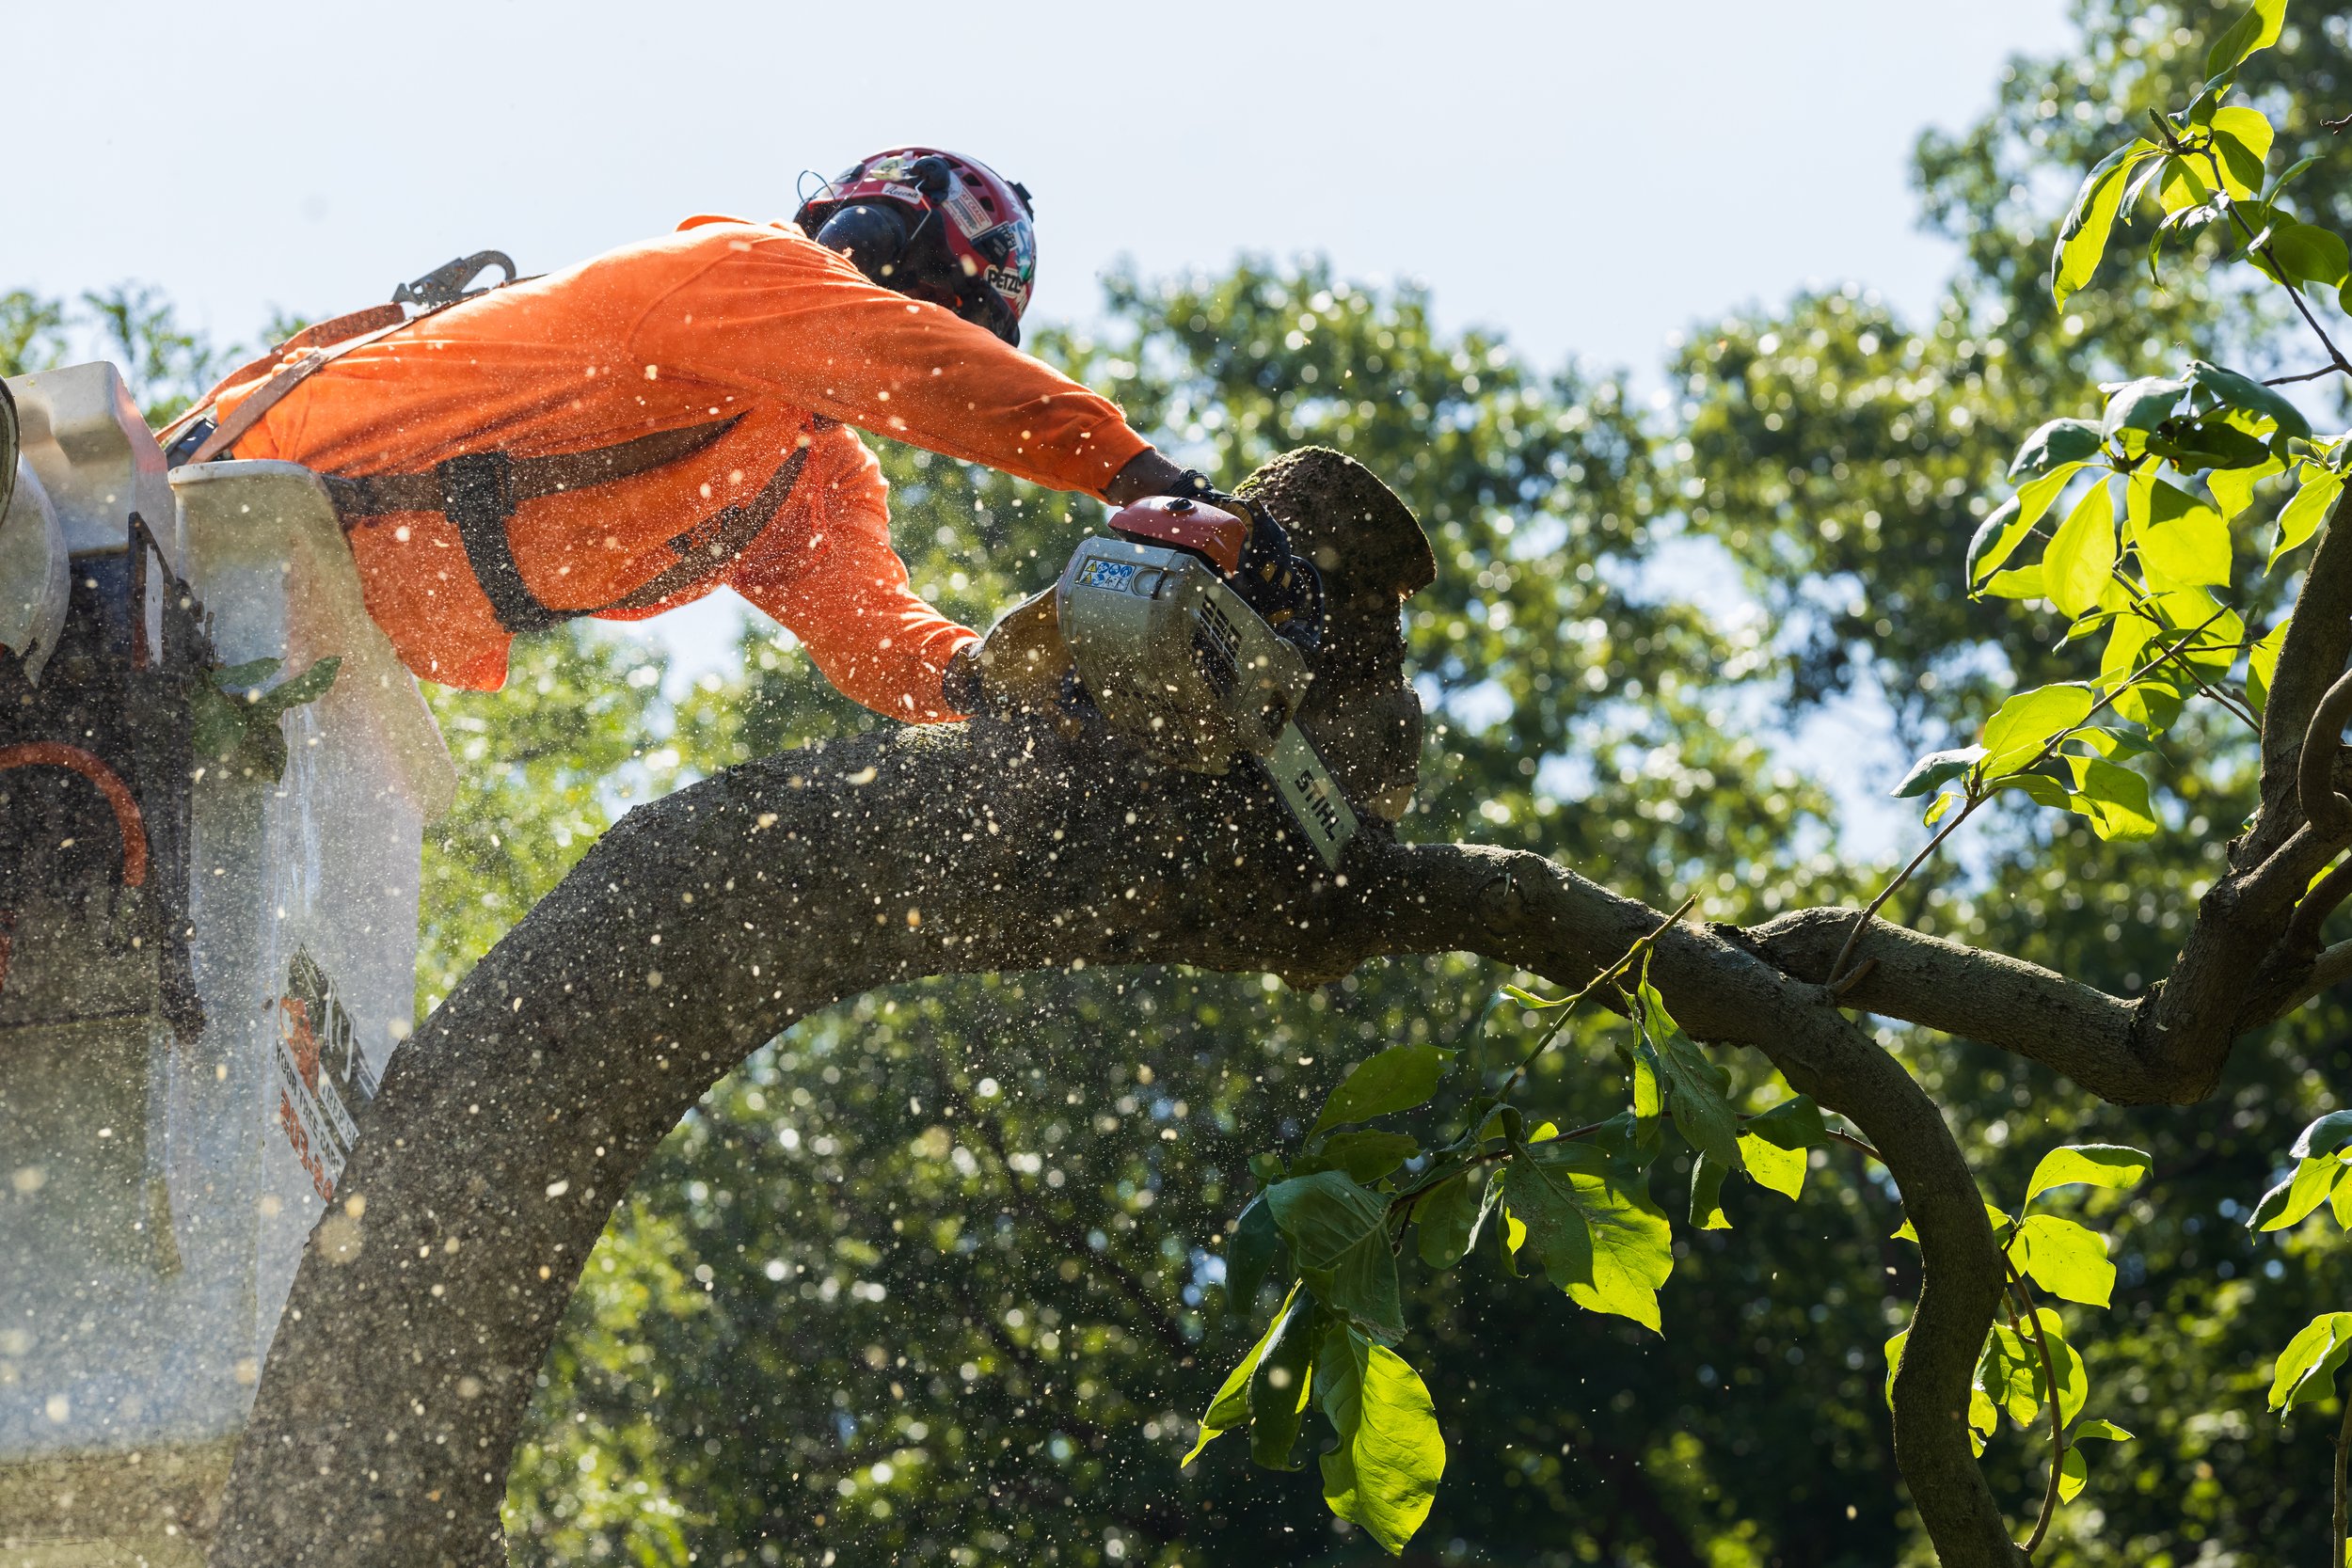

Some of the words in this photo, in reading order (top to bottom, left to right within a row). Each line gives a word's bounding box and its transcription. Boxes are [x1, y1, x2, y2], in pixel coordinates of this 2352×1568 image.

[987, 269, 1024, 293] PETZL
[1294, 769, 1340, 841] STIHL
[276, 1039, 297, 1096] YOUR
[299, 1086, 318, 1139] TREE
